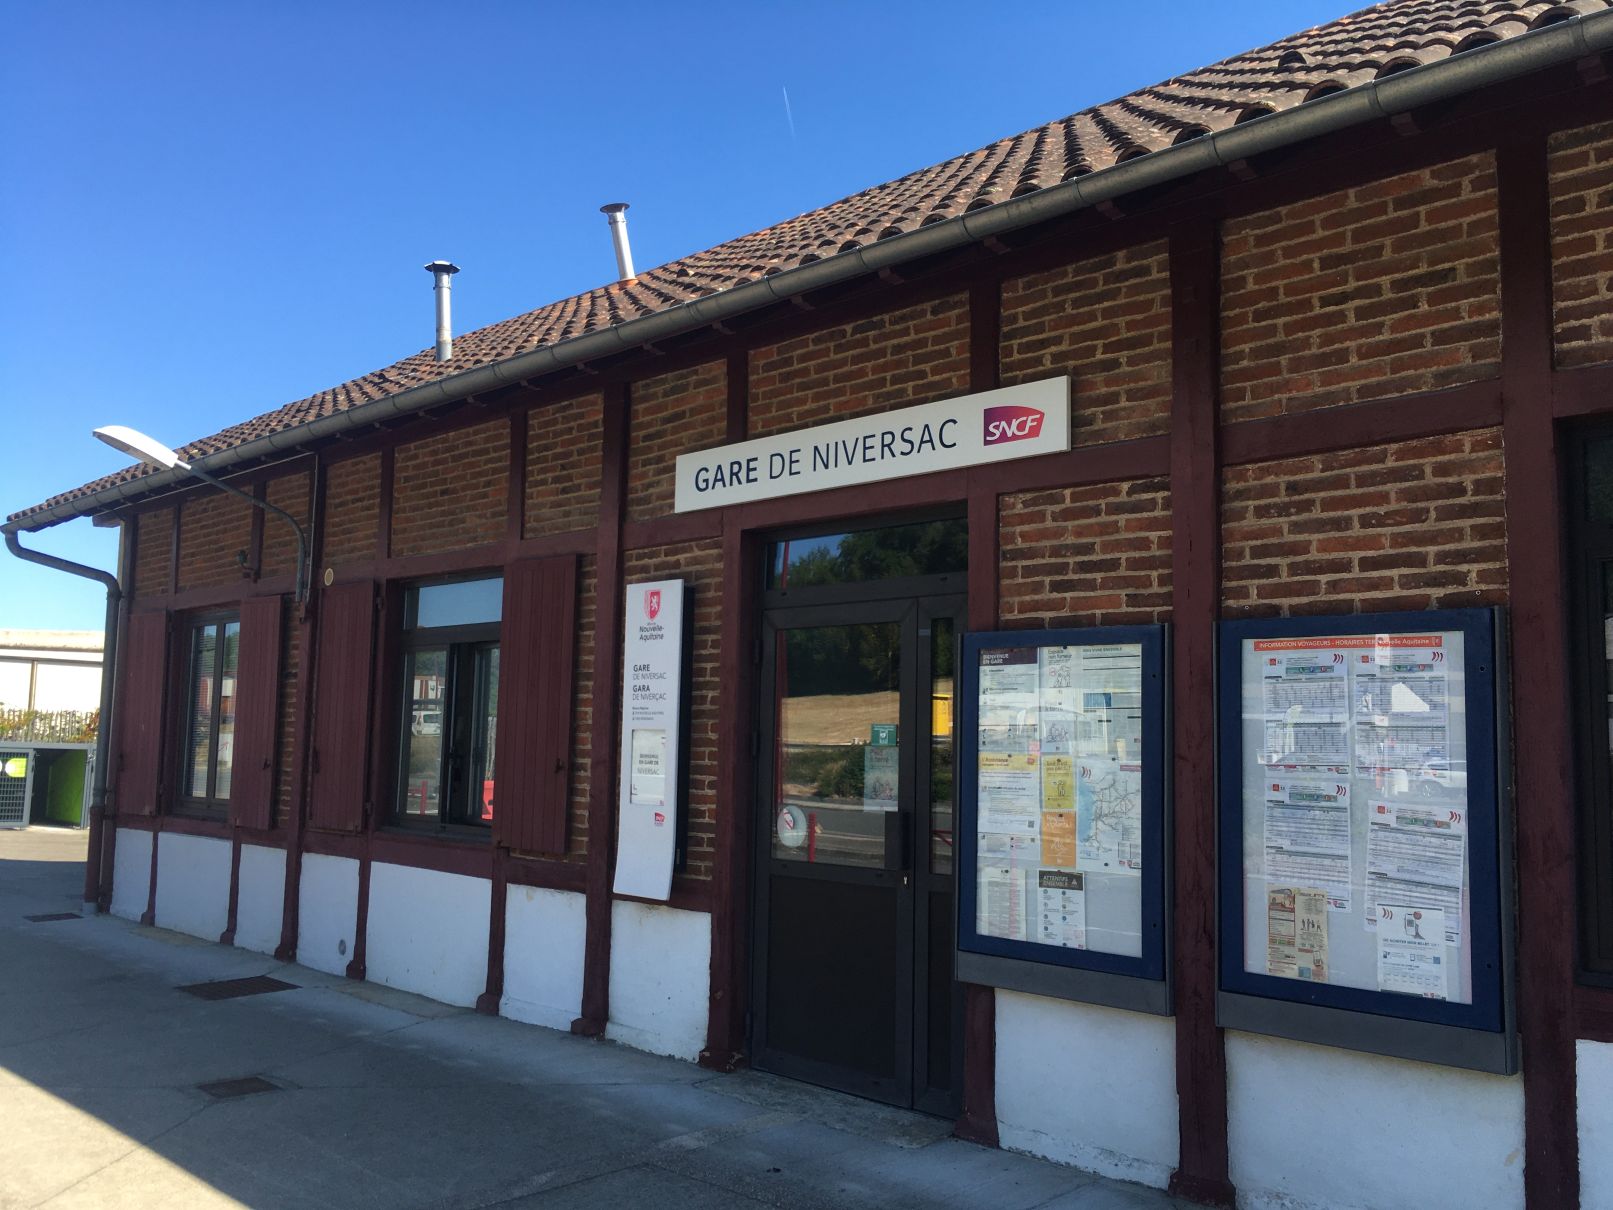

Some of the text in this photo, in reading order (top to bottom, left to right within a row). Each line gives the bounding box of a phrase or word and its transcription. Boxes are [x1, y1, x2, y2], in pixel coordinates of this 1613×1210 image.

[985, 414, 1041, 442] SNCF
[695, 418, 959, 493] GARE DE NIVERSAC
[639, 633, 664, 643] Aquitaine
[1402, 638, 1430, 646] Aquitaine
[633, 664, 651, 673] GARE
[632, 671, 667, 681] DE NIVERSAC
[632, 685, 650, 693] GARA
[641, 692, 667, 702] NIVERÇAC
[637, 767, 660, 776] NIVERSAC
